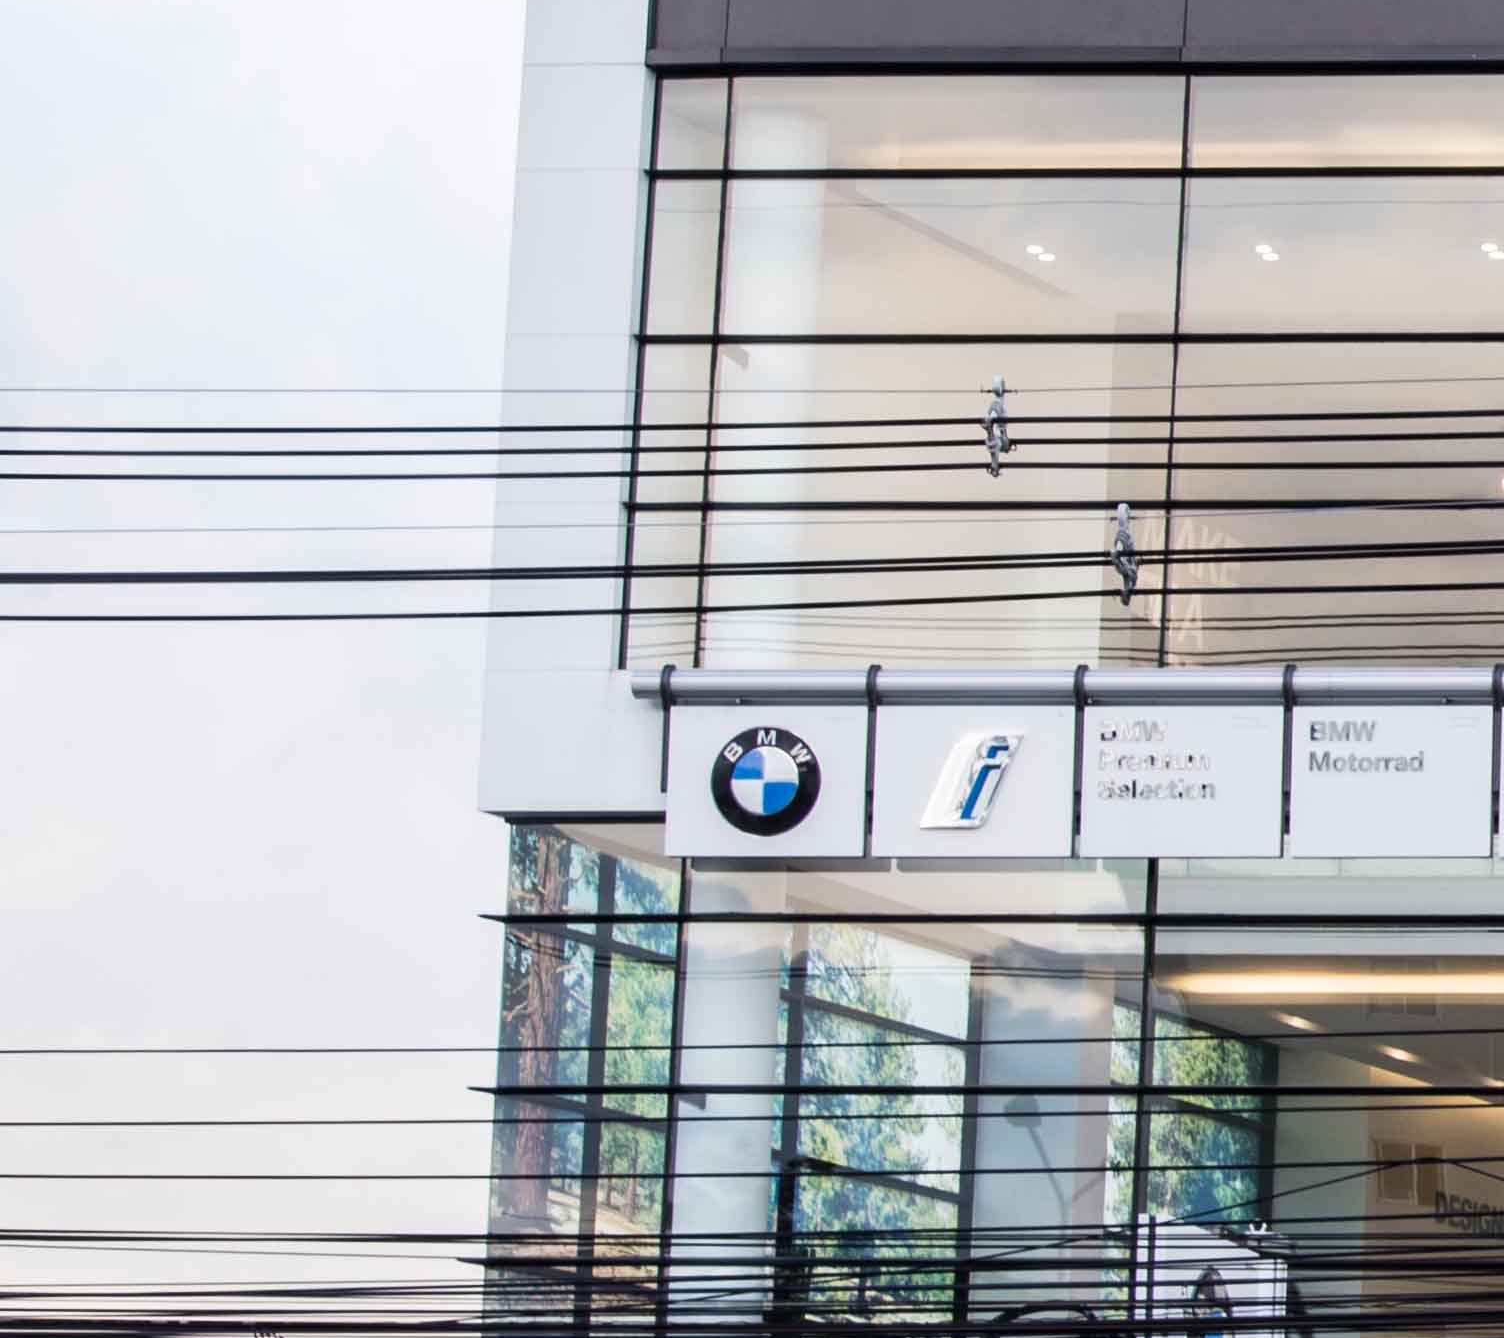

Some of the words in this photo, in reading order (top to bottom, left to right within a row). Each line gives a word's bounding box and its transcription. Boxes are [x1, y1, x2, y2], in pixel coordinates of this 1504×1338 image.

[1309, 720, 1376, 742] BMW
[723, 729, 812, 764] BMW
[1308, 750, 1425, 773] Motorrad
